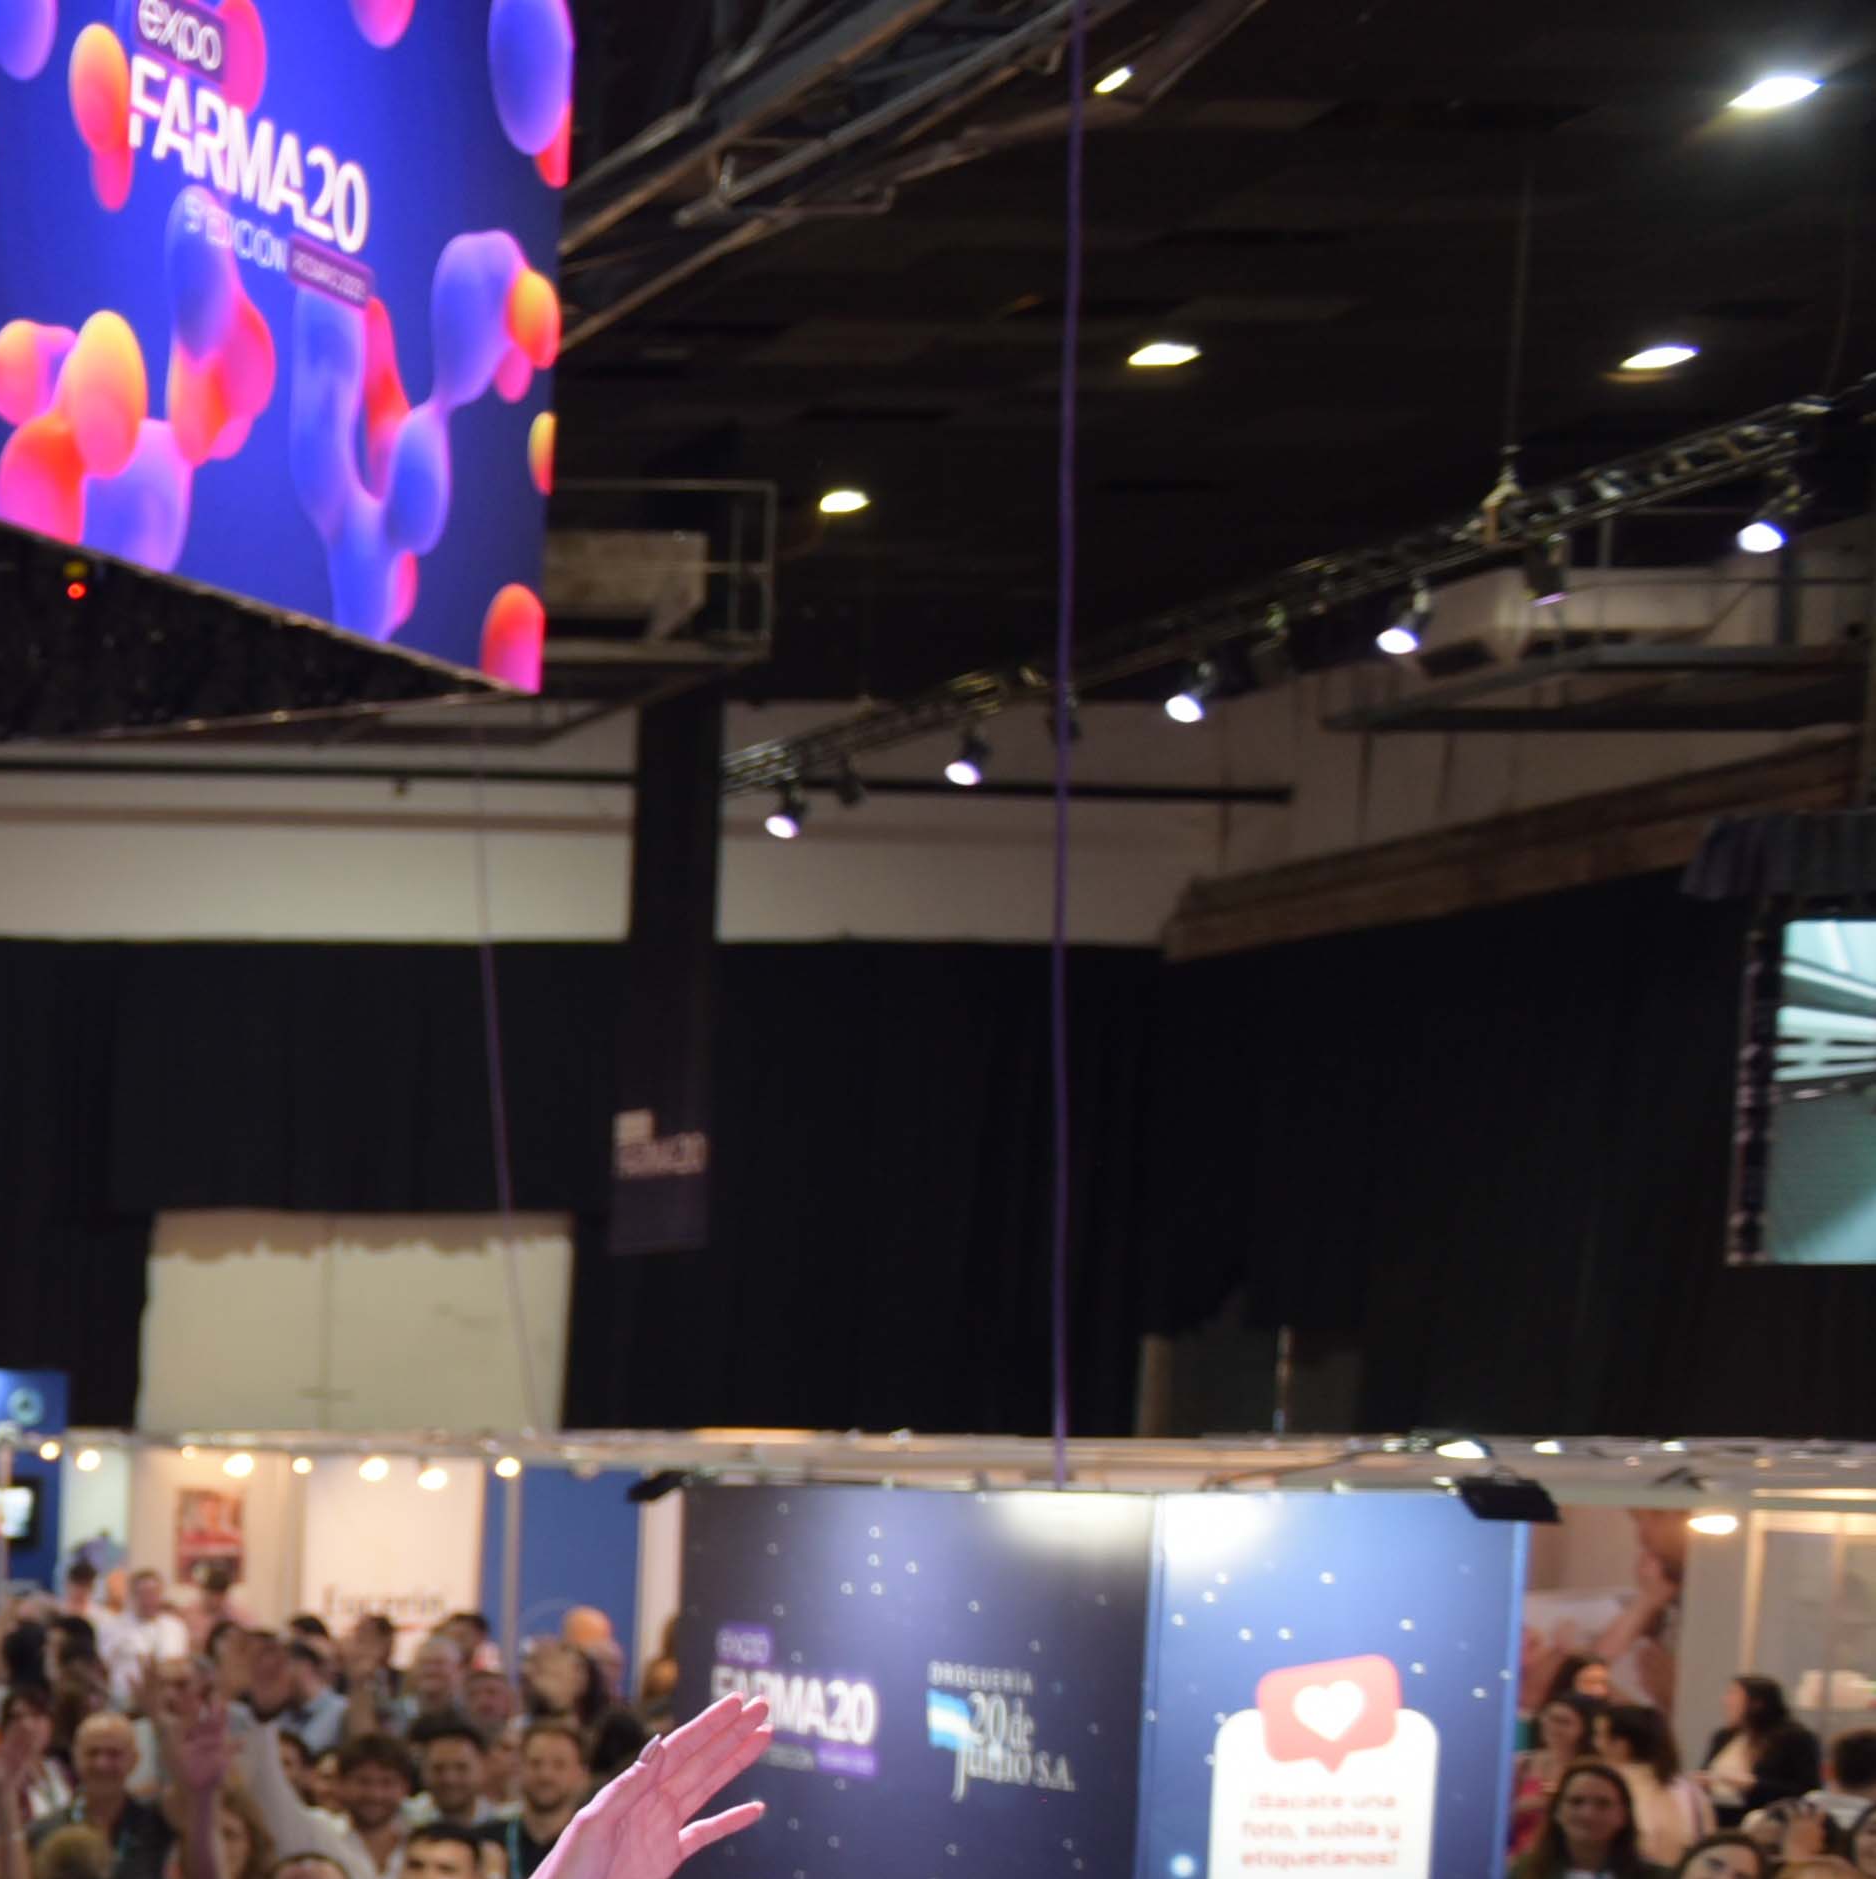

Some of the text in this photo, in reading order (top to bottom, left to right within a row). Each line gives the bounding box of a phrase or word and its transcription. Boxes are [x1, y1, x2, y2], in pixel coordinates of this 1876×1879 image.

[137, 0, 223, 71] expo
[128, 53, 369, 254] FARMA20
[966, 1690, 1035, 1750] 20 de
